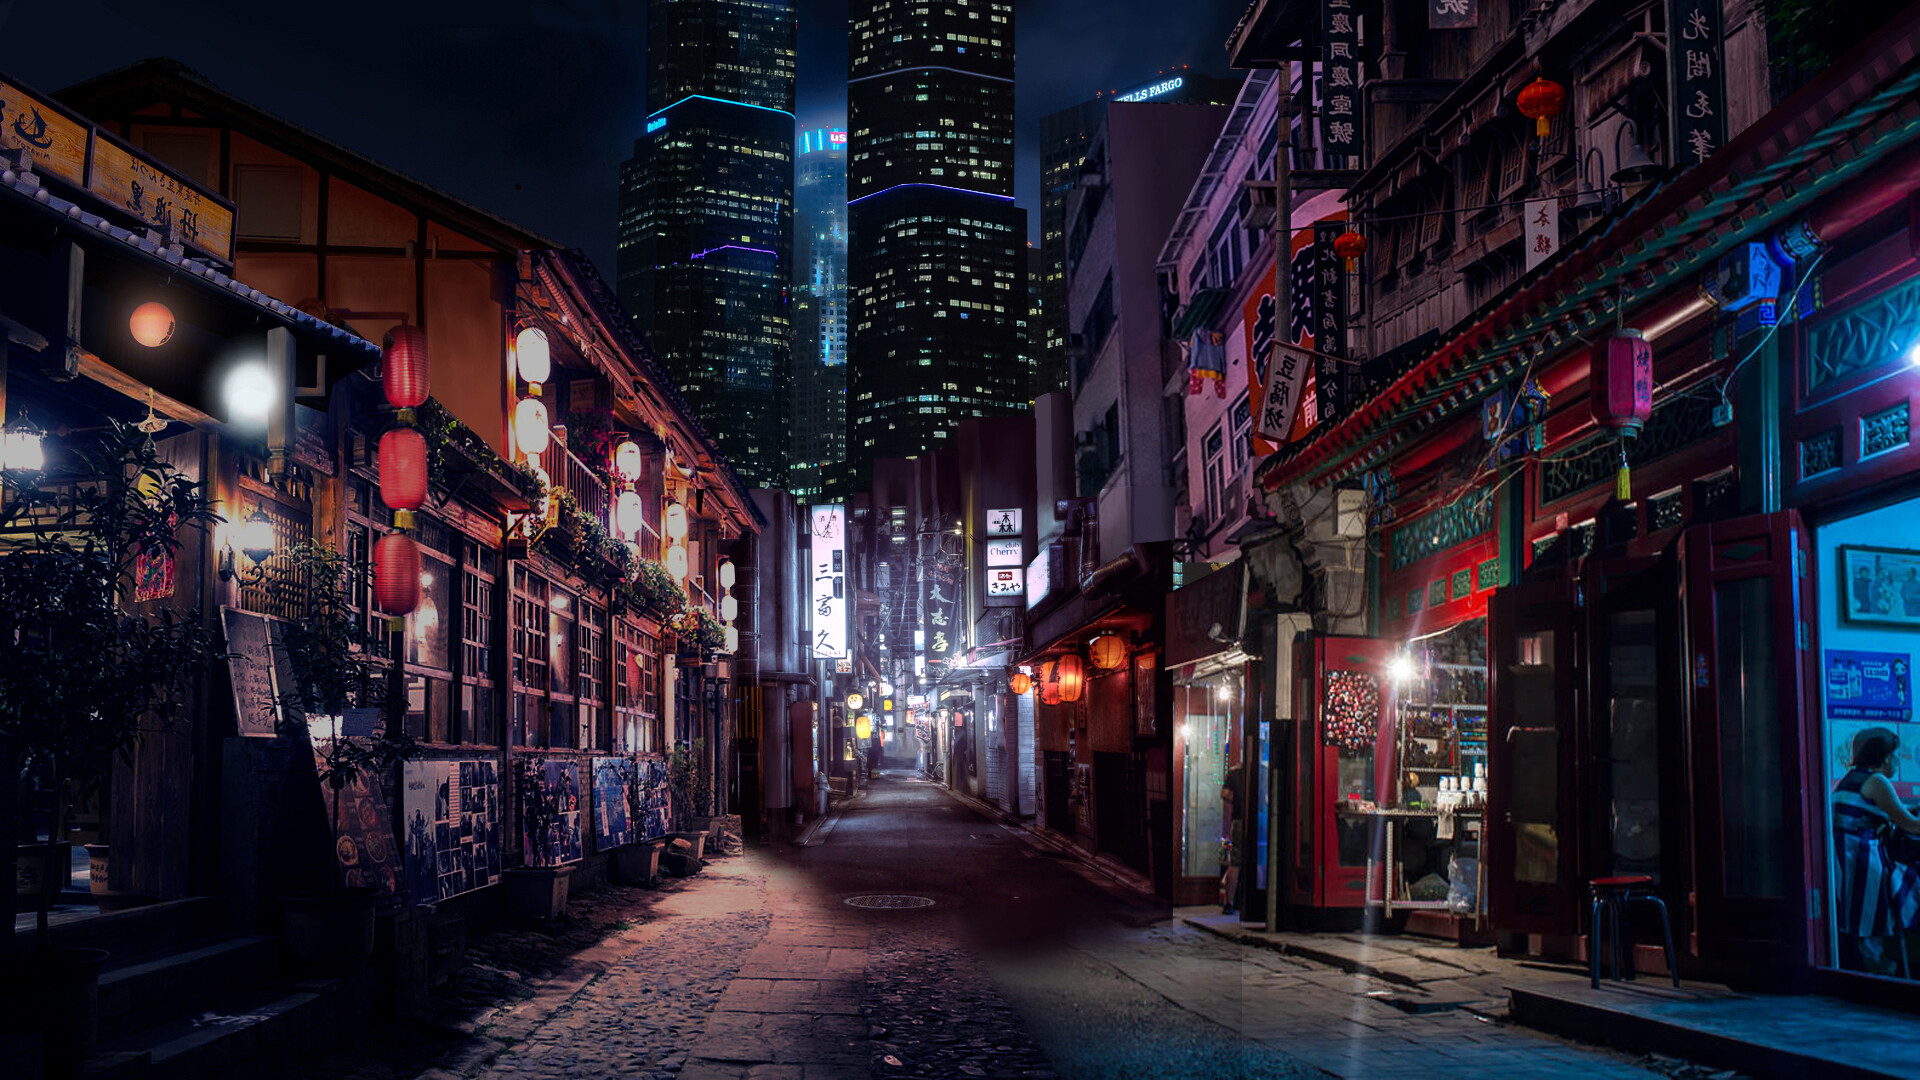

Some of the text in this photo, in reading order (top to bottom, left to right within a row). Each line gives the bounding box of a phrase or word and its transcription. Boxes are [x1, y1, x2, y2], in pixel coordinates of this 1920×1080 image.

[1149, 78, 1182, 97] FARGO
[1005, 541, 1020, 549] club
[990, 548, 1019, 556] Cherry
[991, 581, 1021, 594] きみや
[815, 563, 835, 650] 三富久
